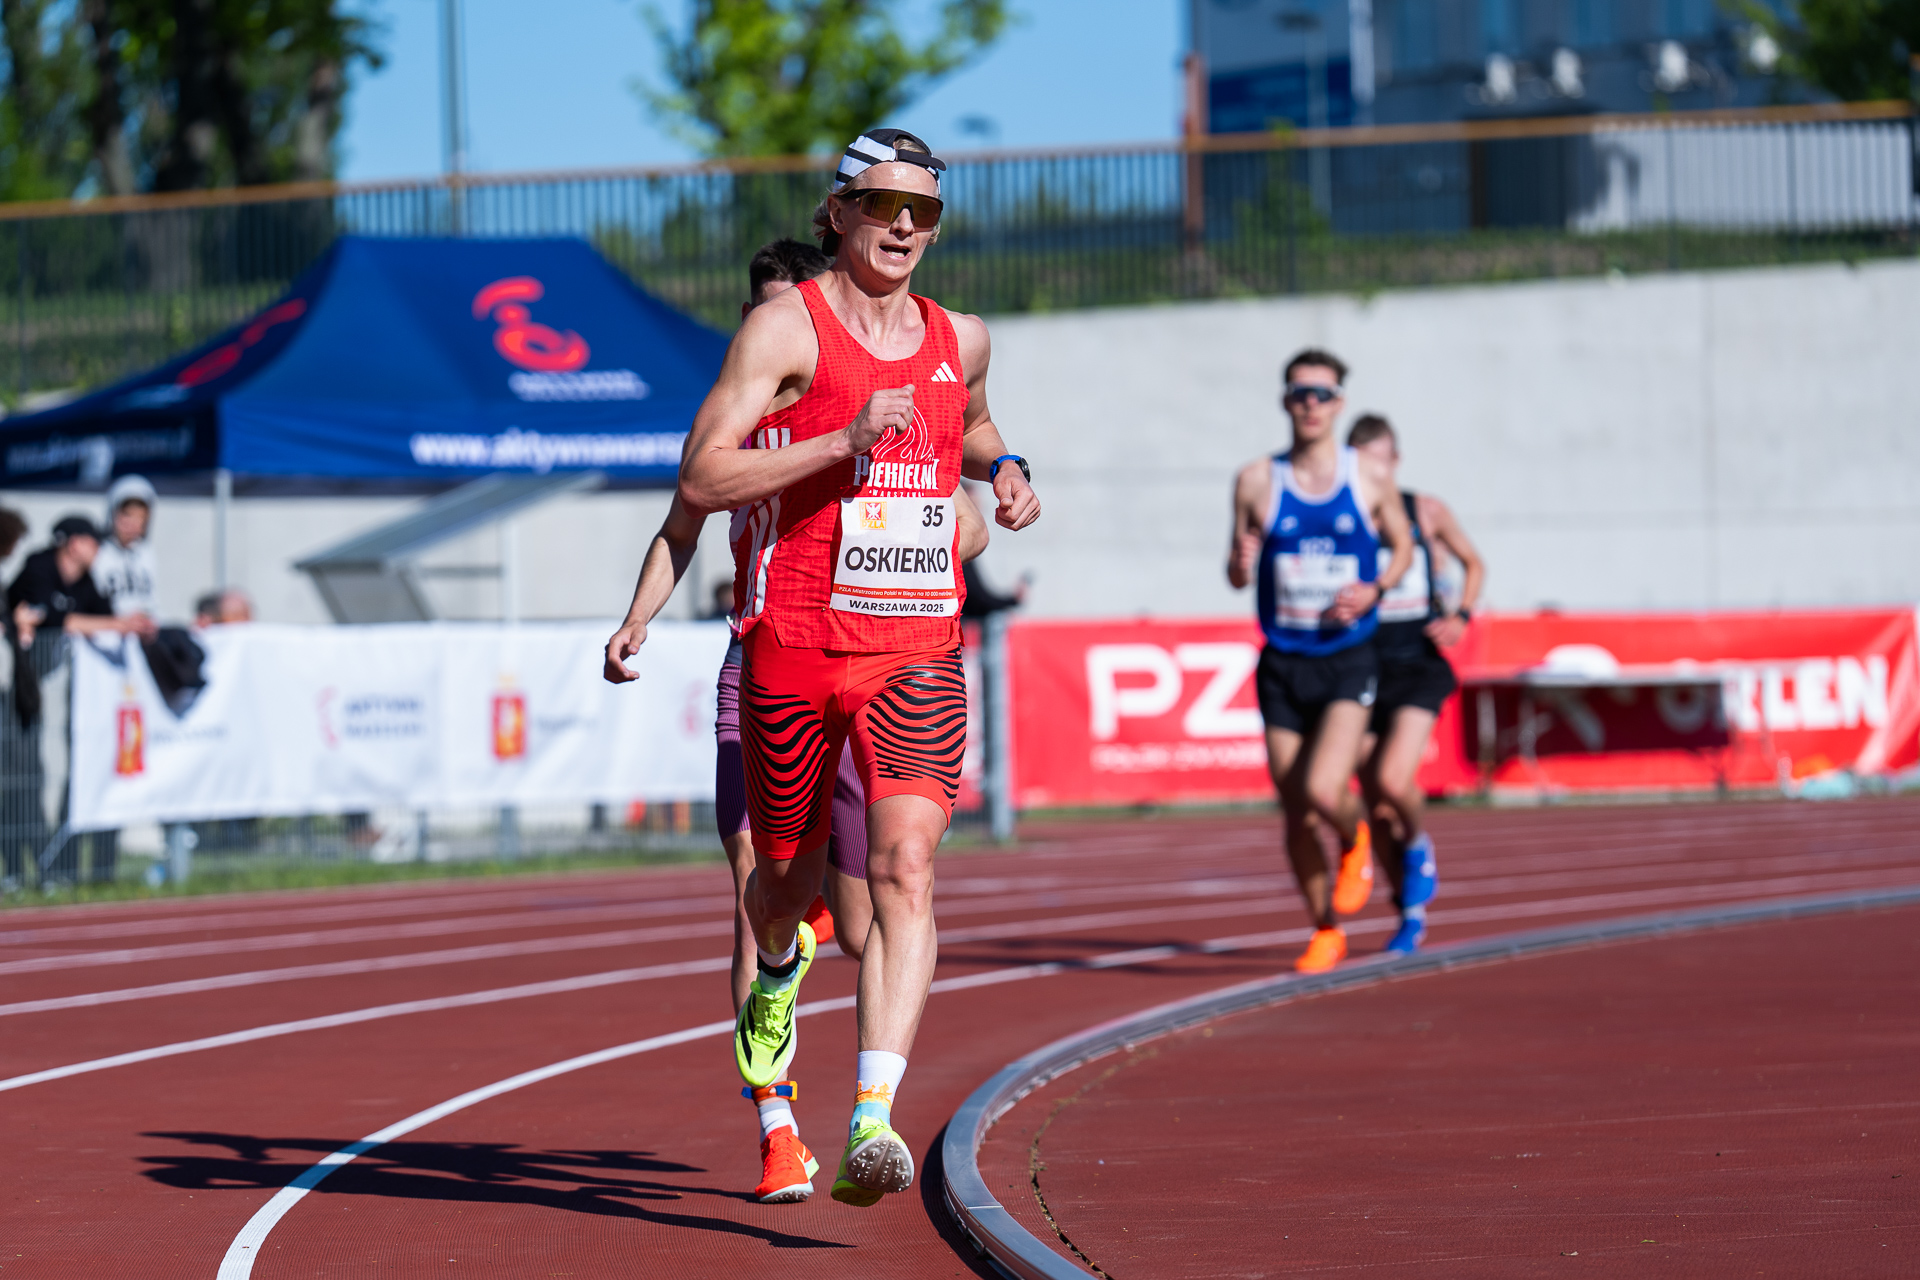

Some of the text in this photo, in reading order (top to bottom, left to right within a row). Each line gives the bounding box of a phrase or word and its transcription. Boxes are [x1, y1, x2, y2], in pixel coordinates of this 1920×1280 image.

[853, 455, 940, 490] PIEKIELNI
[922, 504, 944, 527] 35
[844, 546, 949, 573] OSKIERKO
[849, 599, 945, 613] WARSZAWA 2025
